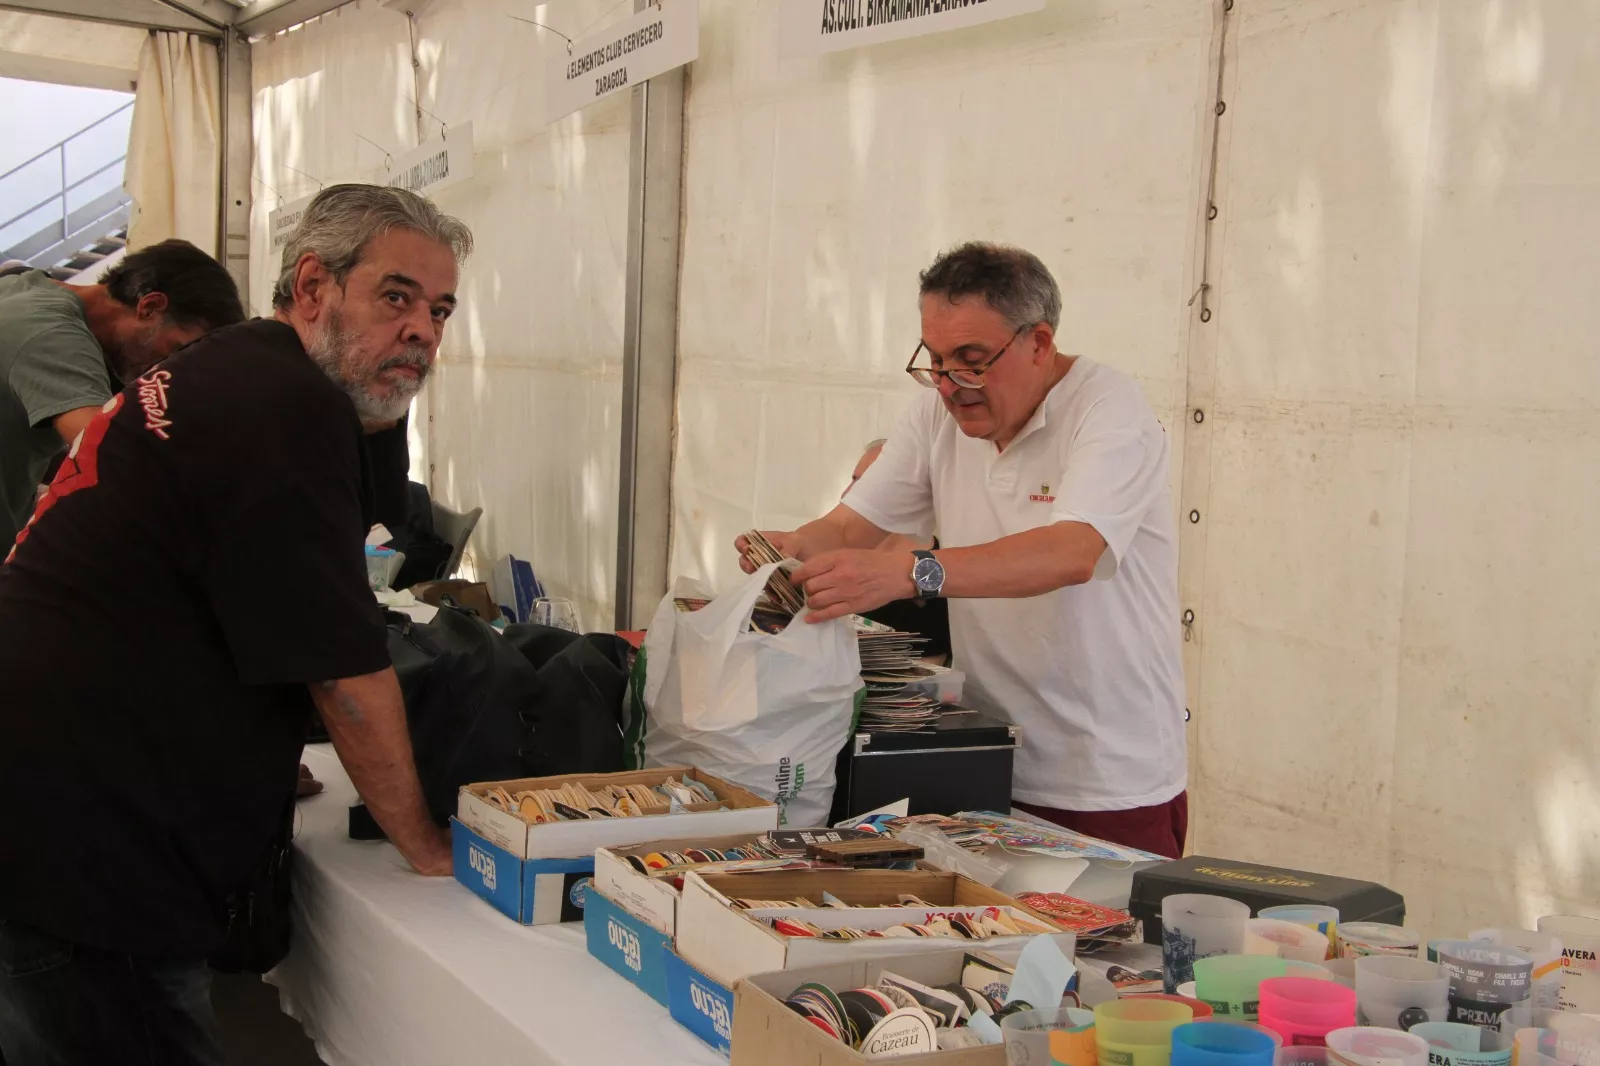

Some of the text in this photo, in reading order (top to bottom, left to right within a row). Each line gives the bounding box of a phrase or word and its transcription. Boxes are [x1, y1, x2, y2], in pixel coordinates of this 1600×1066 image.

[571, 47, 605, 79] ELEMENTOS
[606, 39, 622, 63] CLUB
[623, 20, 663, 54] CERVECERO
[595, 66, 628, 96] ZARAGOZA
[608, 920, 641, 959] tecno
[1561, 947, 1596, 960] AVERA
[690, 983, 731, 1028] tecno
[870, 1034, 919, 1054] Cazeau
[882, 1025, 920, 1040] Brasserie de
